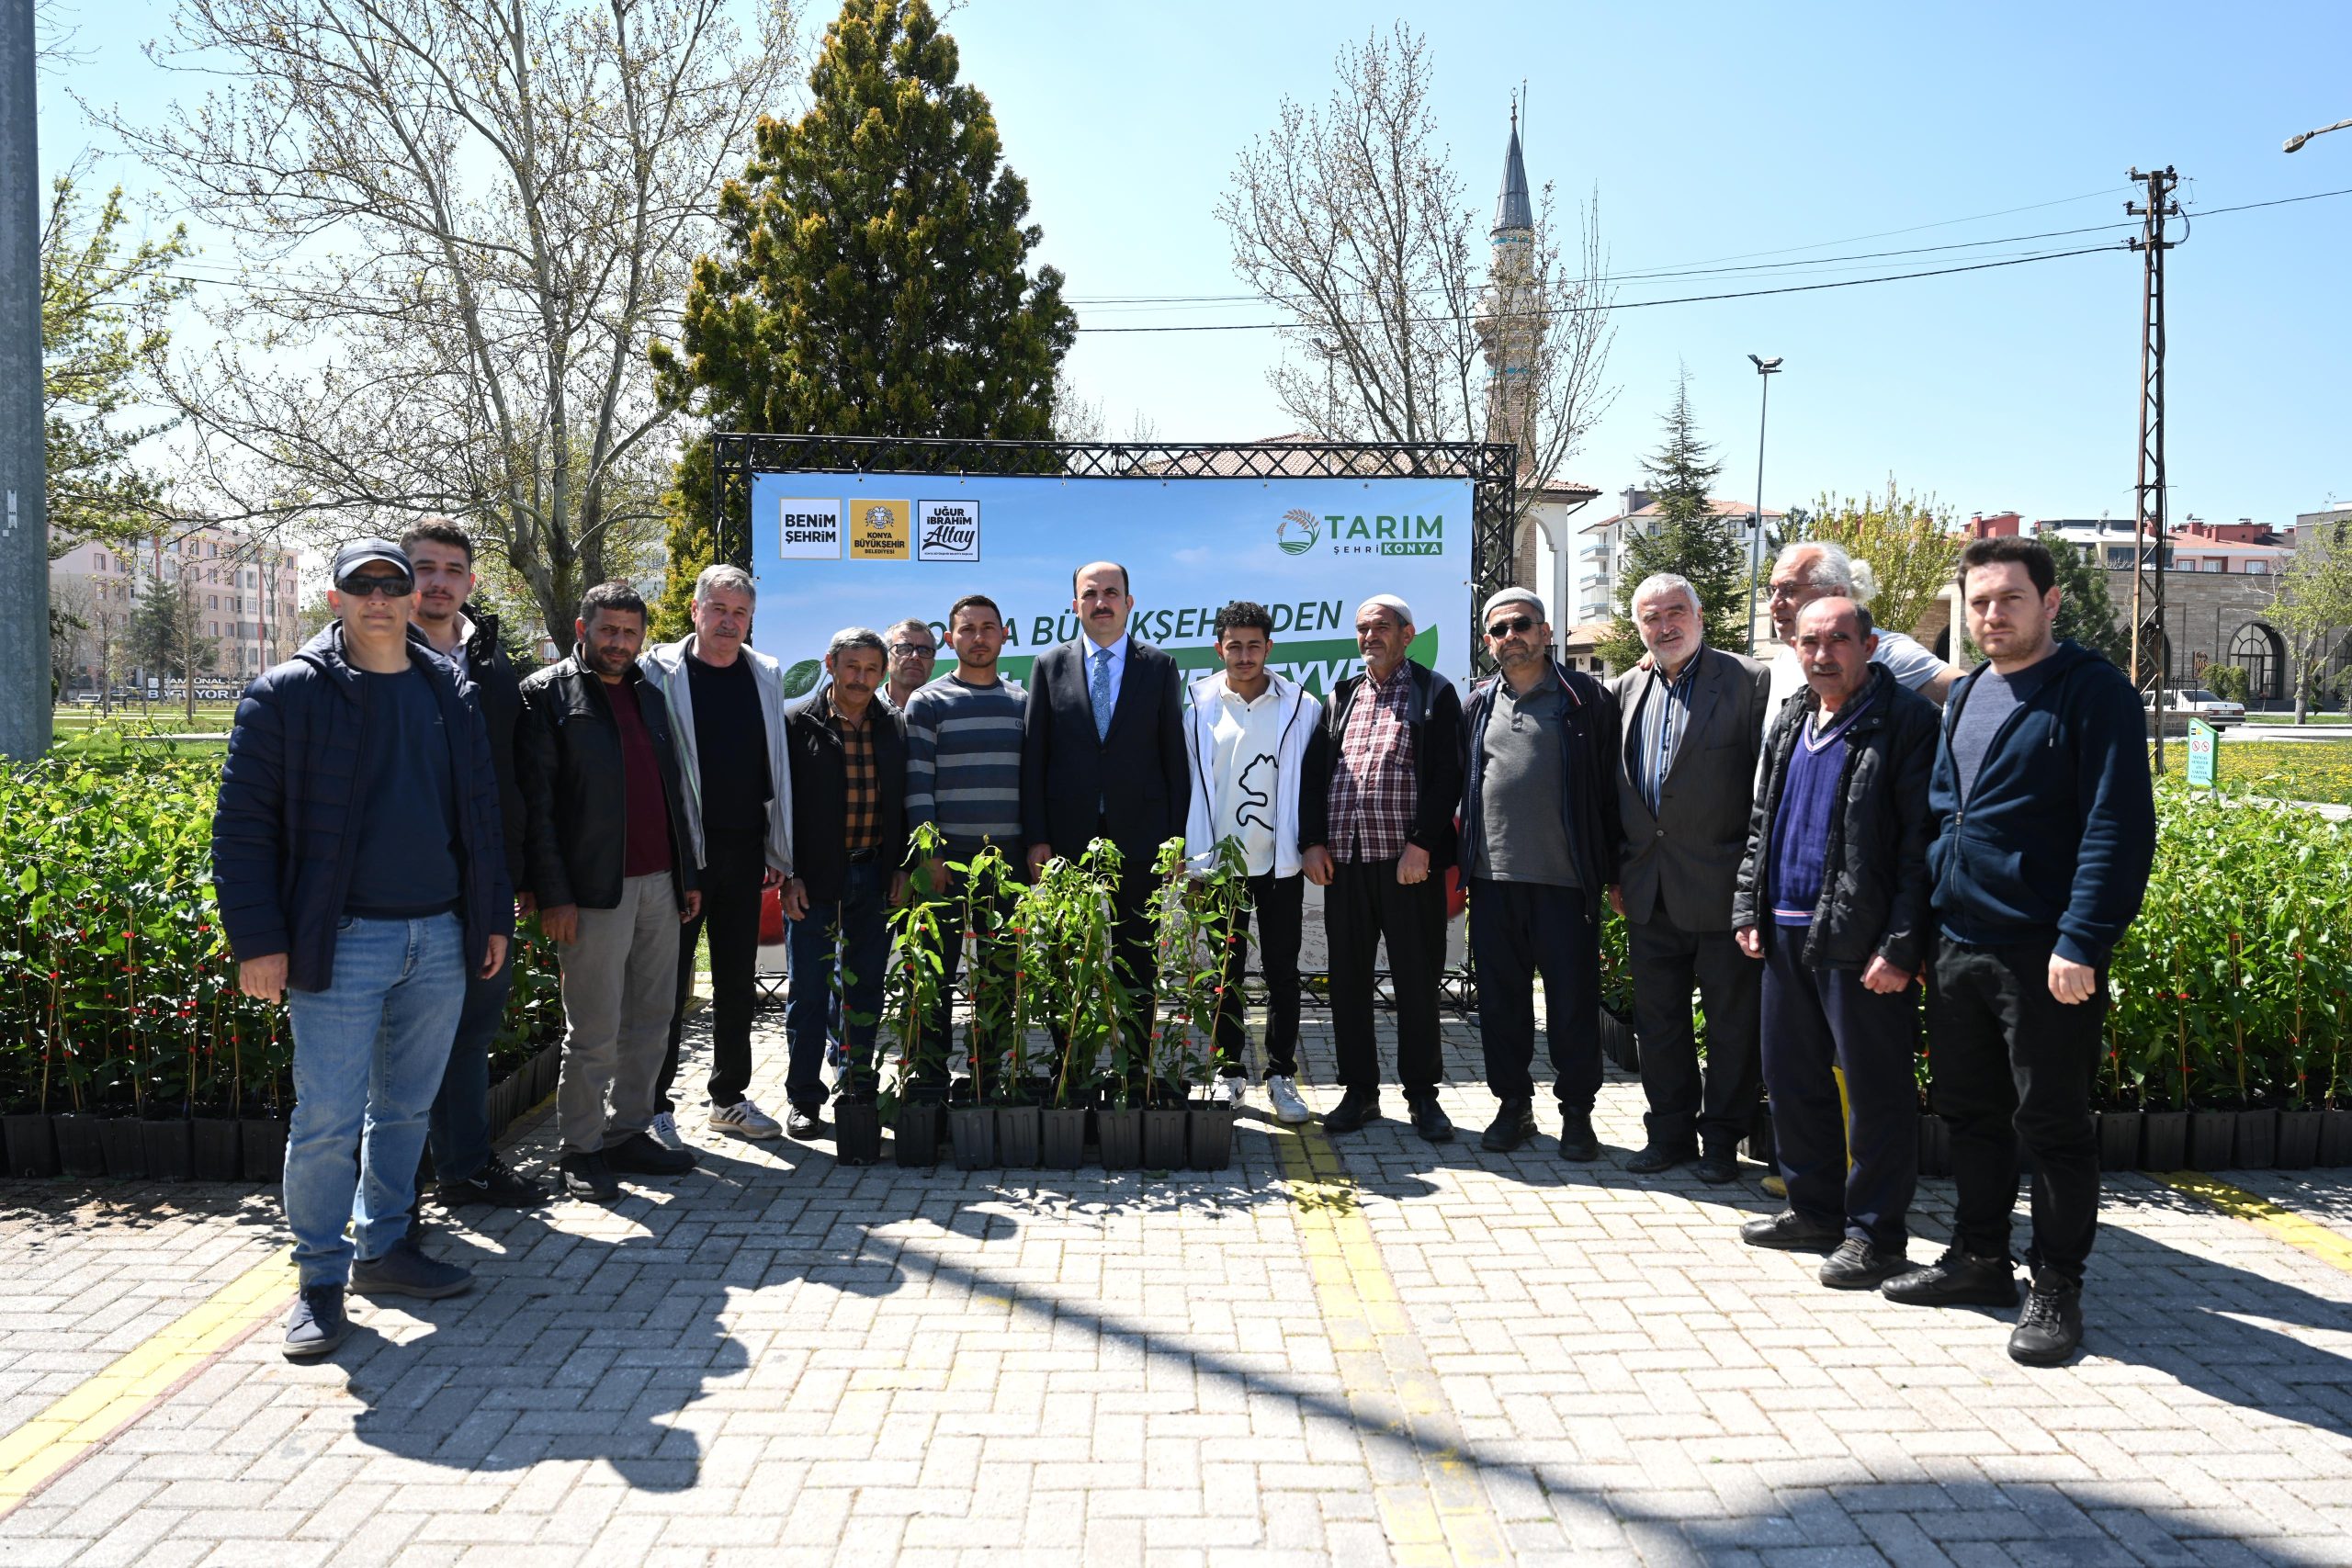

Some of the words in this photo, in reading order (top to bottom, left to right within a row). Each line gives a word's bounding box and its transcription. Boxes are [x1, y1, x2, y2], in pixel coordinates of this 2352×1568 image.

[933, 505, 965, 517] UĞUR
[1324, 514, 1443, 539] TARIM
[854, 538, 905, 548] BÜYÜKŞEHİR
[922, 525, 976, 551] Altay
[1333, 544, 1379, 555] ŞEHRİ
[1384, 543, 1441, 554] KONYA
